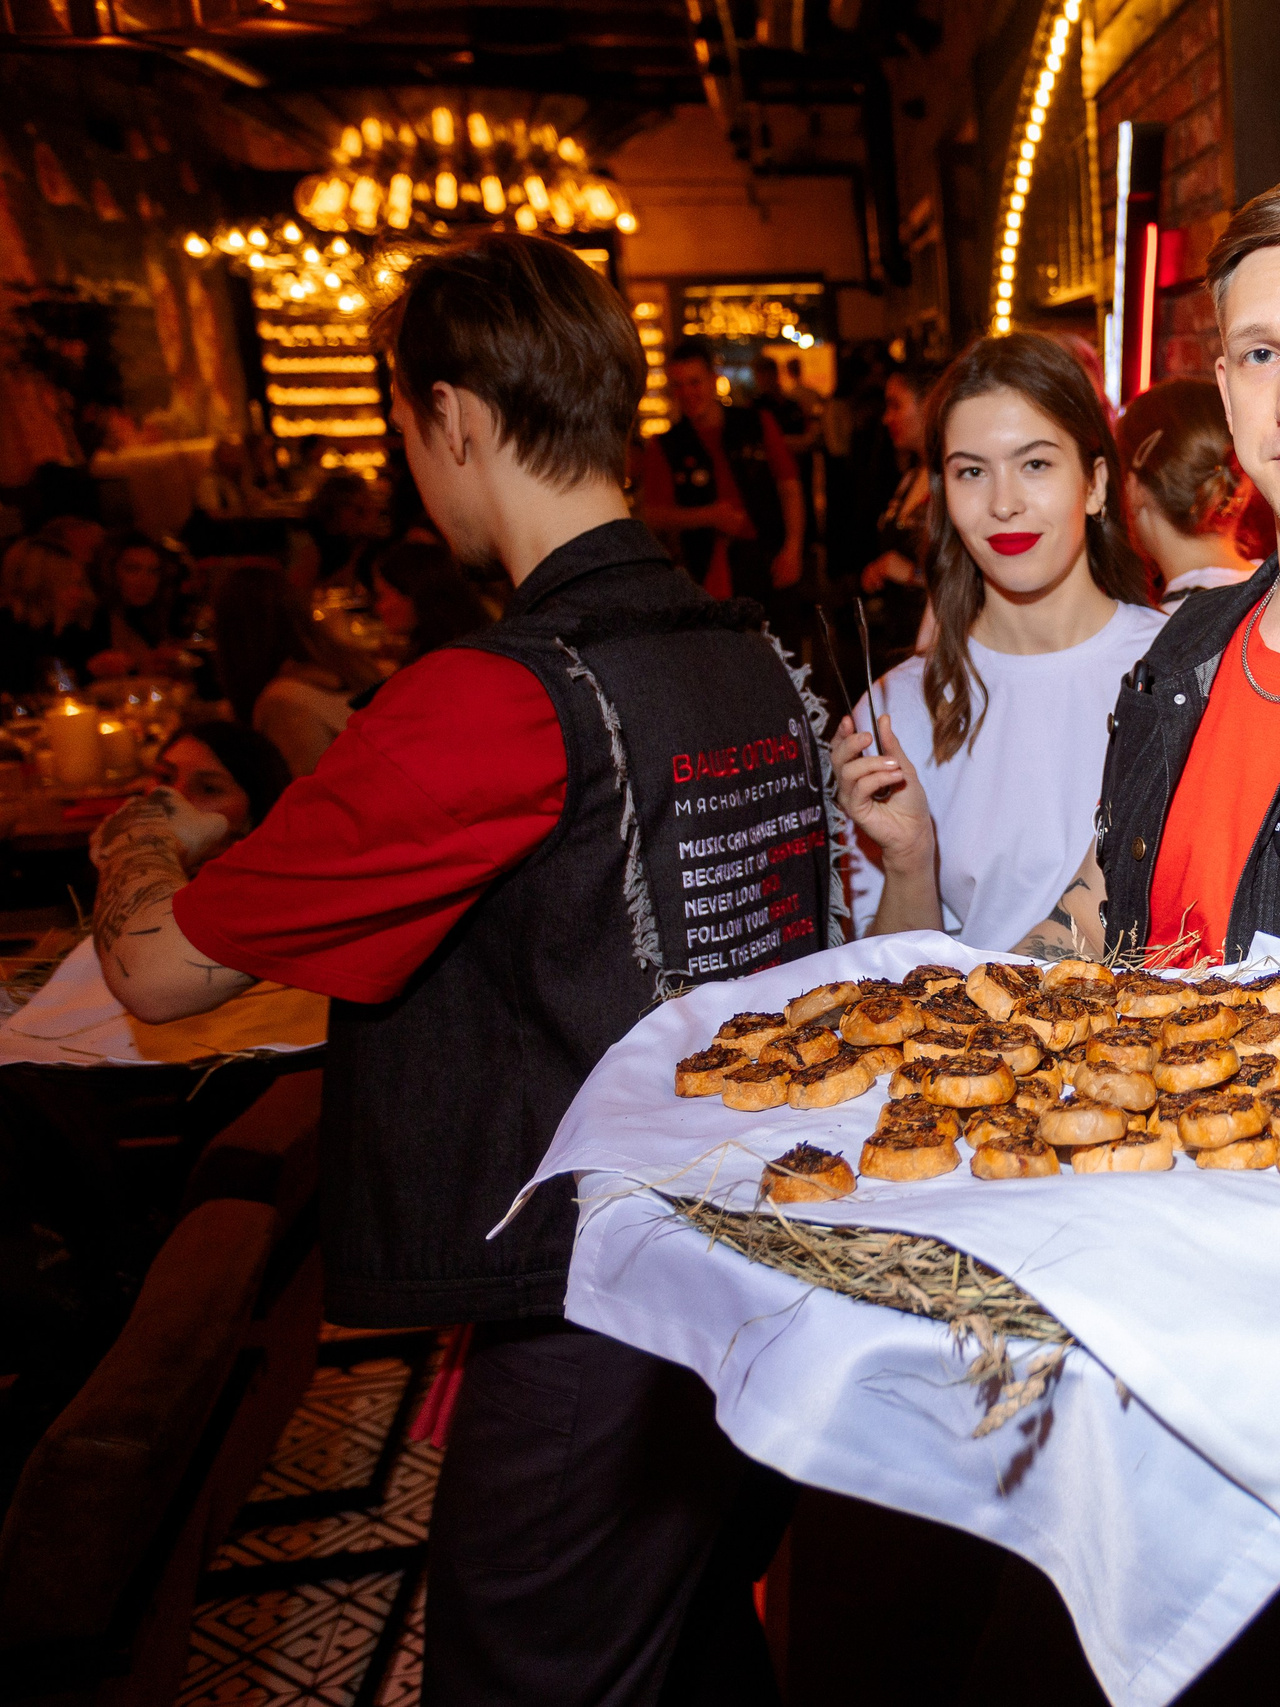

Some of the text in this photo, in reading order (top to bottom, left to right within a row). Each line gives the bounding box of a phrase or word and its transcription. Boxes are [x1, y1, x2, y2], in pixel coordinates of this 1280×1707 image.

[742, 734, 799, 770] ОГОНЬ
[745, 773, 806, 804] РЕСТОРАН
[679, 834, 725, 860] MUSIC
[727, 829, 749, 852] CAN
[777, 811, 799, 833] THE
[798, 805, 822, 826] WRLD
[681, 859, 743, 889] BECAUSE
[744, 856, 755, 875] IT
[684, 891, 734, 918] NEVER
[735, 882, 762, 907] LOOK
[687, 916, 742, 949] FOLLOW
[744, 906, 770, 933] YOUR
[688, 951, 728, 977] FEEL
[730, 944, 750, 966] THE
[750, 928, 781, 959] ENERGY
